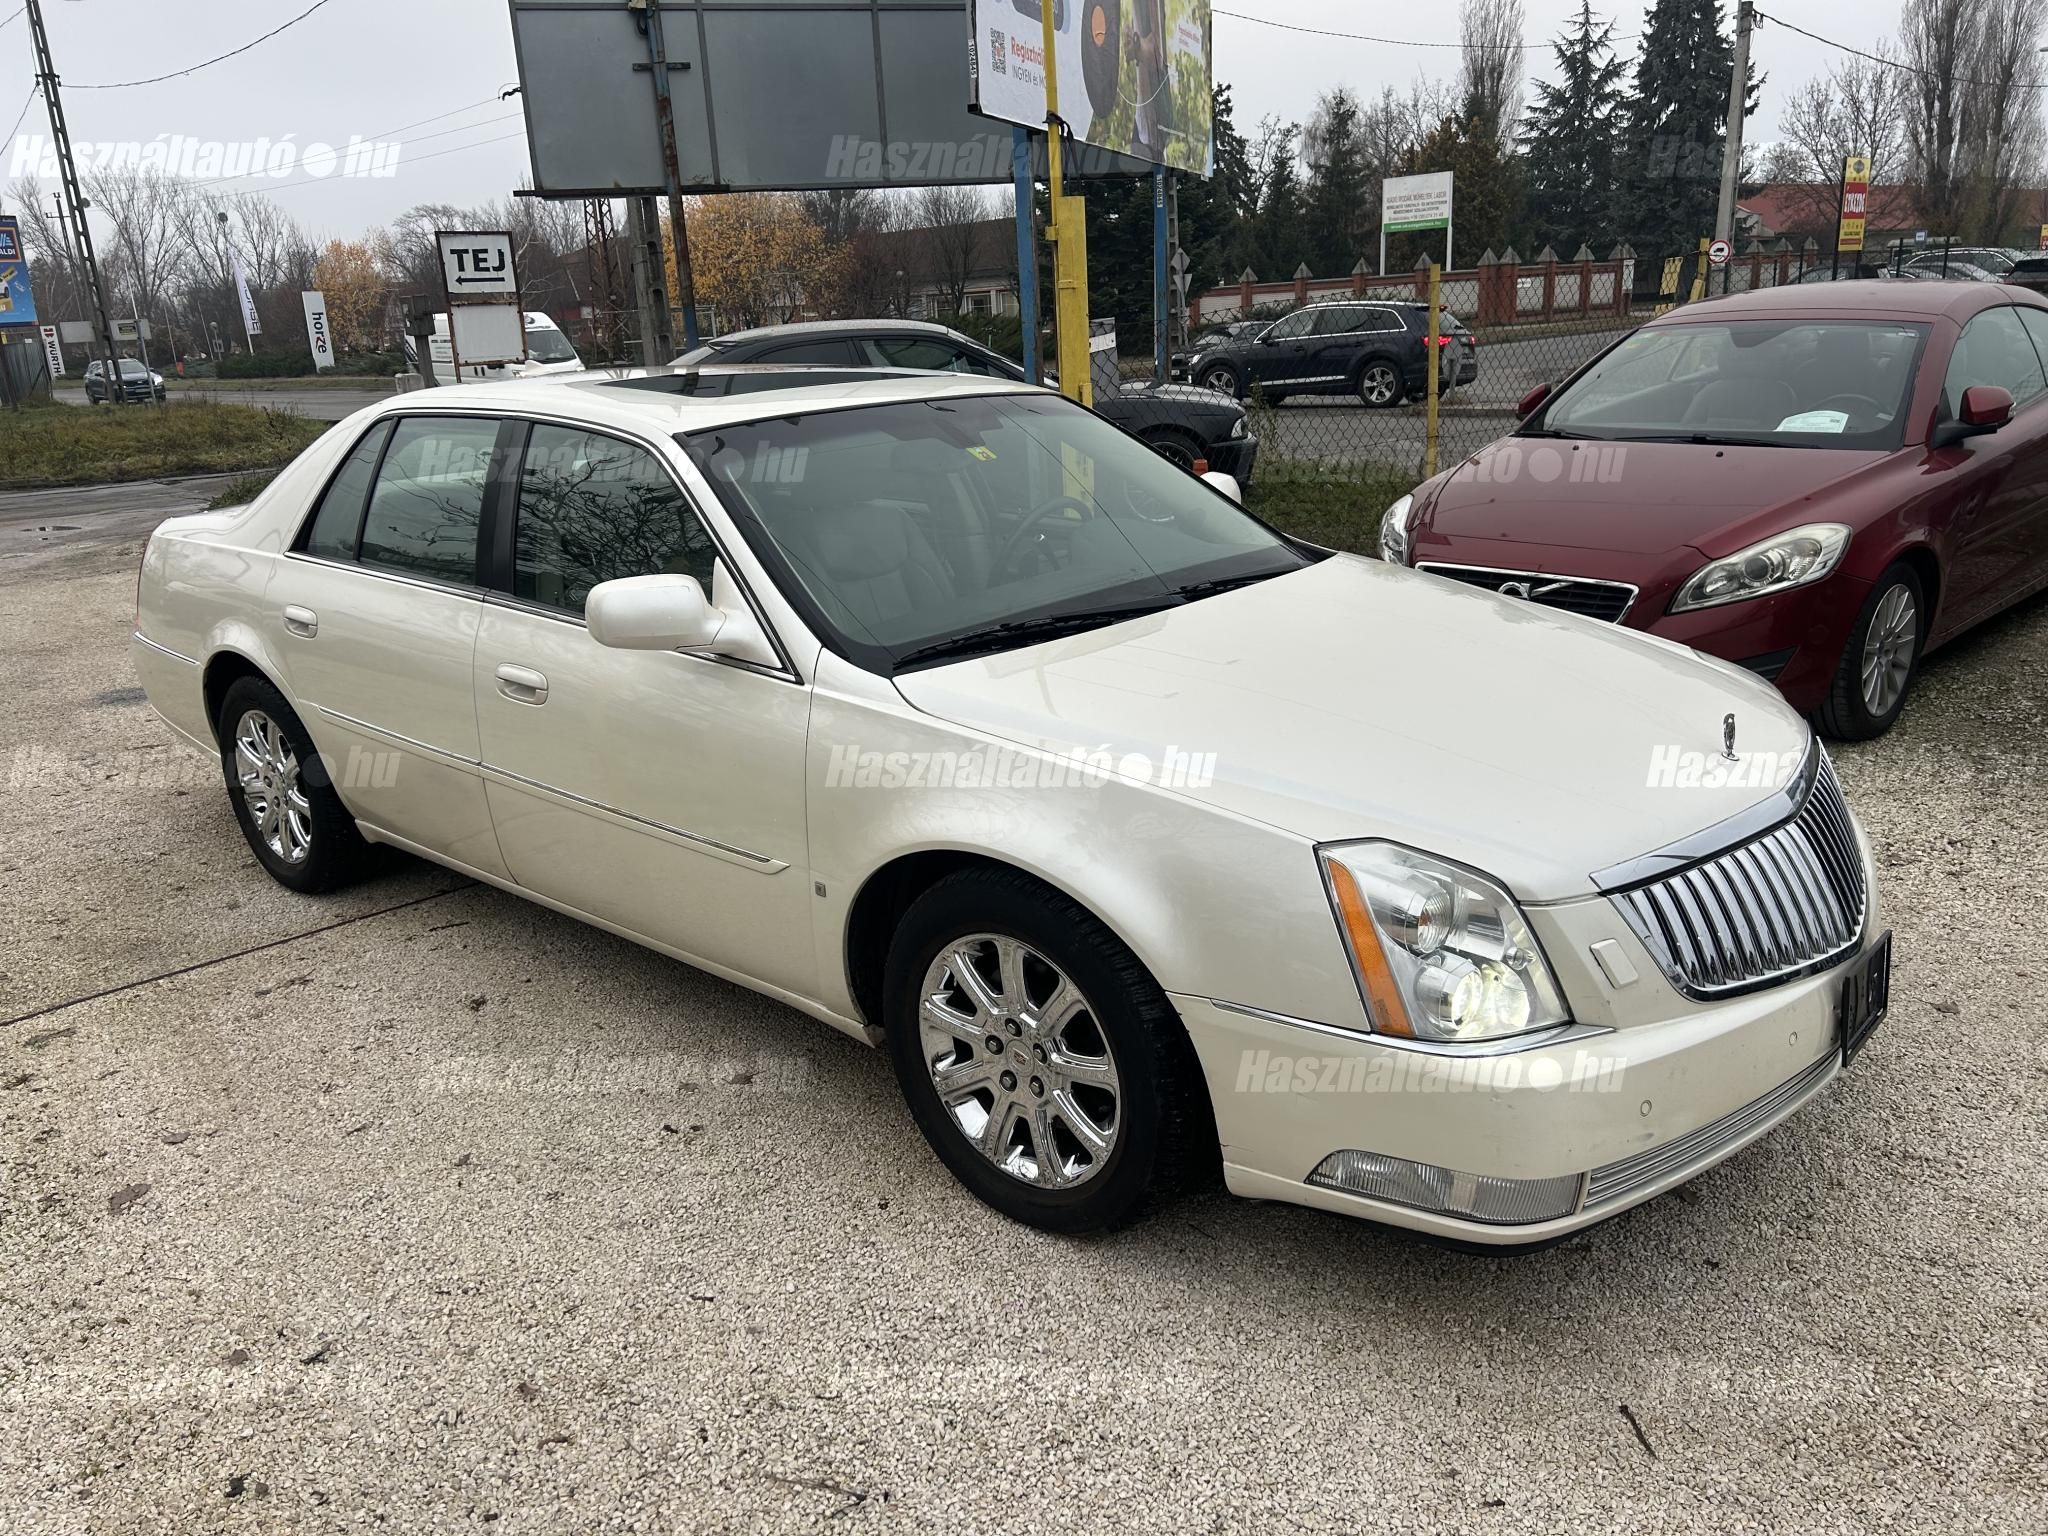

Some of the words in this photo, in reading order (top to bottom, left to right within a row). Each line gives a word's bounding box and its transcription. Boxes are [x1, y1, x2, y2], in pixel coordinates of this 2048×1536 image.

[450, 248, 506, 272] TEJ
[311, 312, 327, 354] horze
[48, 340, 61, 374] WÜRTH
